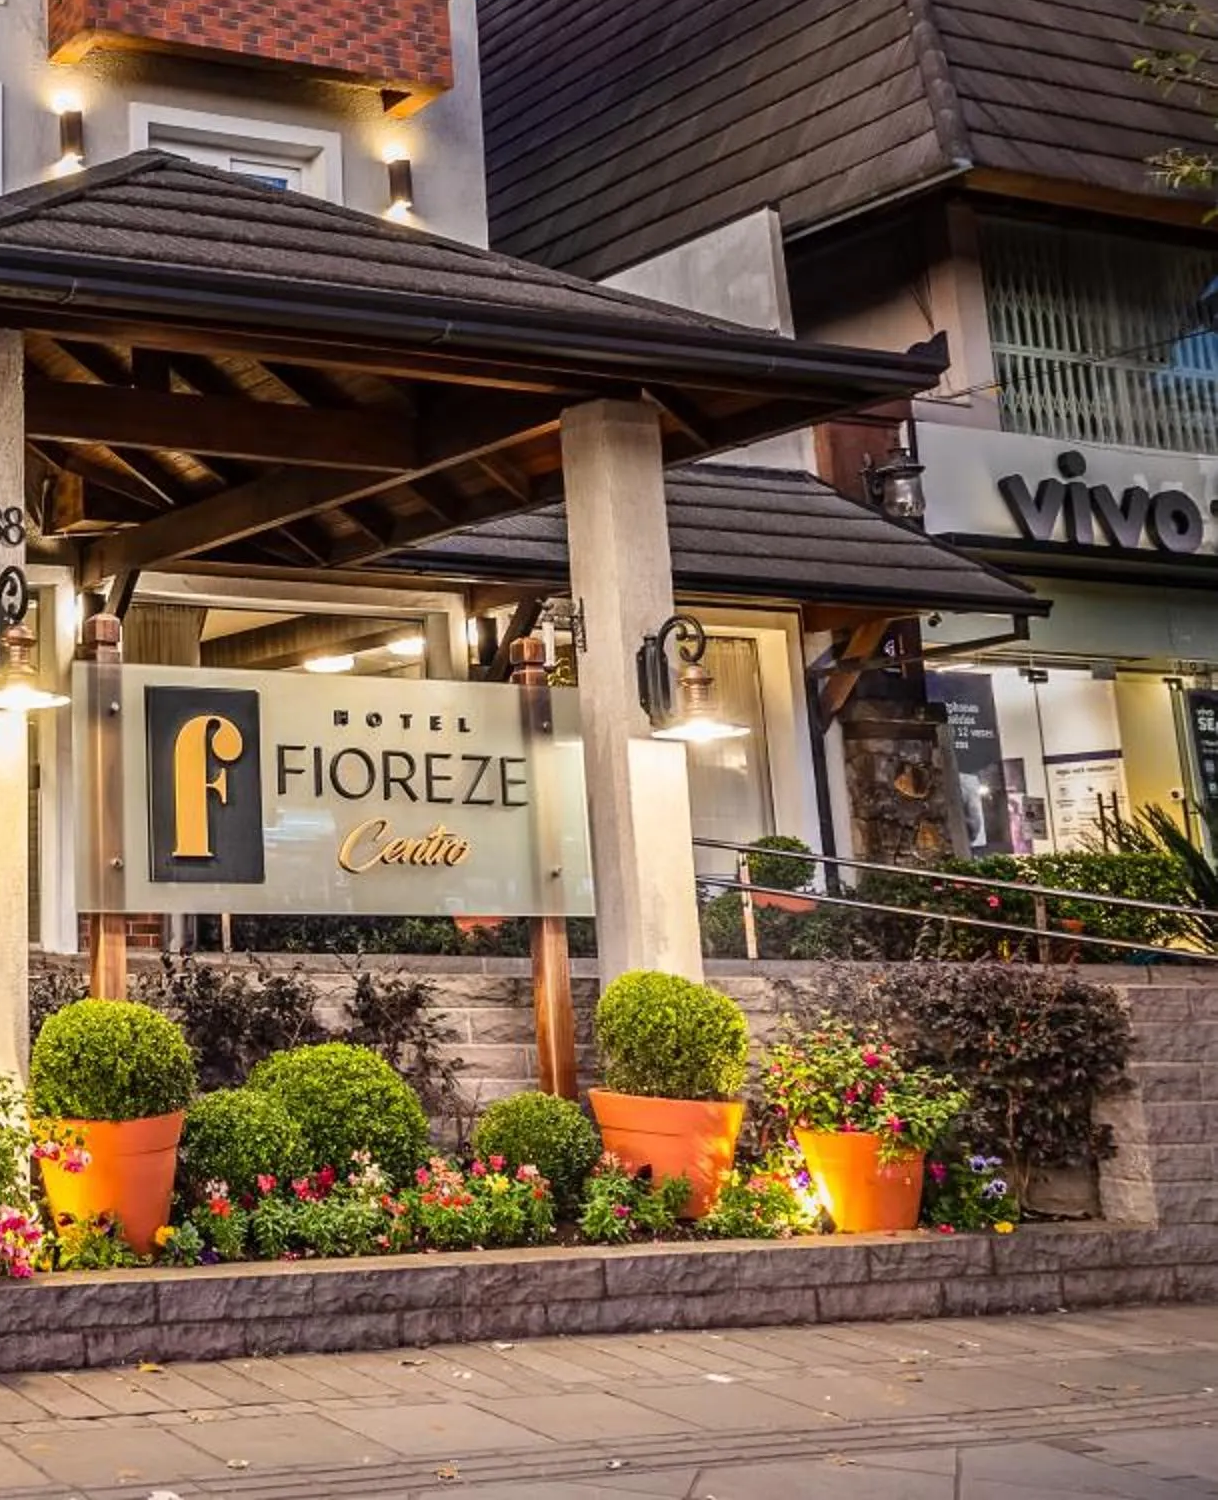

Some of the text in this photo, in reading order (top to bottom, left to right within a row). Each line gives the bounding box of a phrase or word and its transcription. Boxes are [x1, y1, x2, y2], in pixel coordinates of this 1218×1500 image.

[997, 450, 1204, 553] vivo
[333, 709, 471, 733] HOTEL
[276, 743, 529, 807] FIOREZE
[337, 816, 473, 875] Centro
